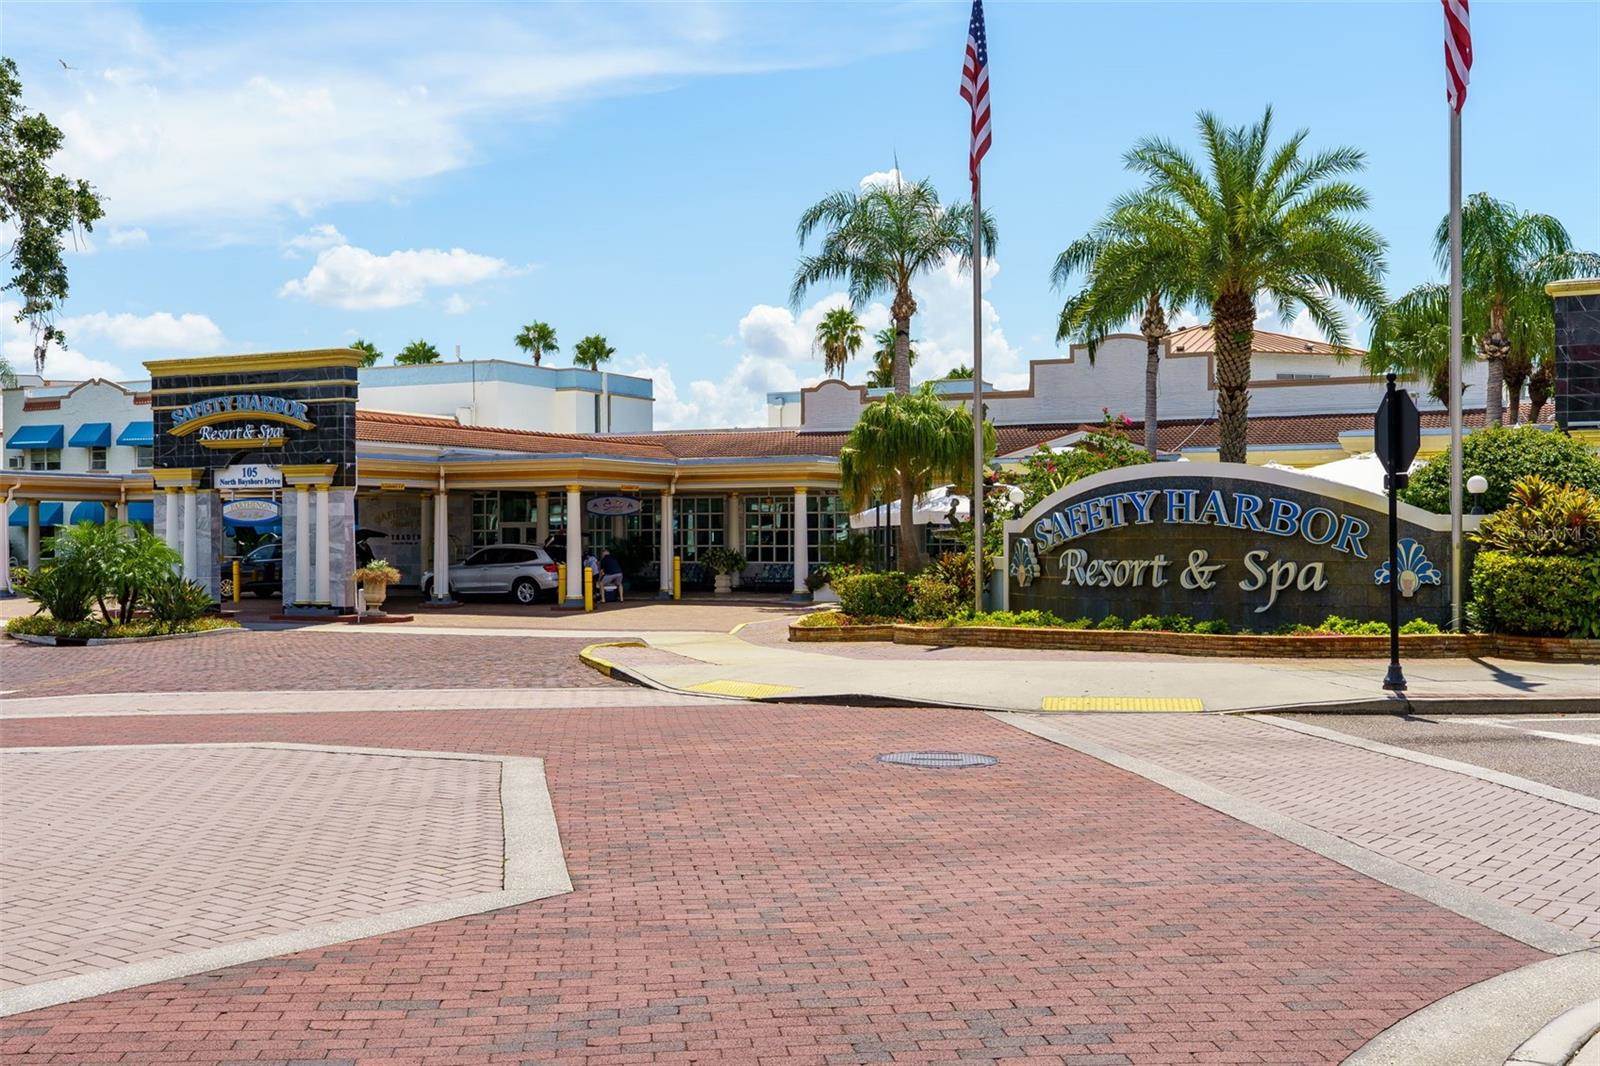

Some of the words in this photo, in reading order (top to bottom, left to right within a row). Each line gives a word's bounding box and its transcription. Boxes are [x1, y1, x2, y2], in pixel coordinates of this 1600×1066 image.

[171, 396, 237, 427] SAFETY
[236, 394, 308, 421] HARBOR
[199, 426, 242, 440] Resort
[242, 424, 255, 438] &
[257, 424, 284, 447] Spa
[219, 478, 237, 486] North
[237, 478, 264, 487] Bayshore
[264, 478, 281, 486] Drive
[242, 467, 258, 478] 105
[1033, 490, 1161, 554] SAFETY
[1163, 489, 1371, 559] HARBOR
[1059, 548, 1170, 588] Resort
[1180, 549, 1226, 591] &
[1238, 549, 1329, 613] Spa
